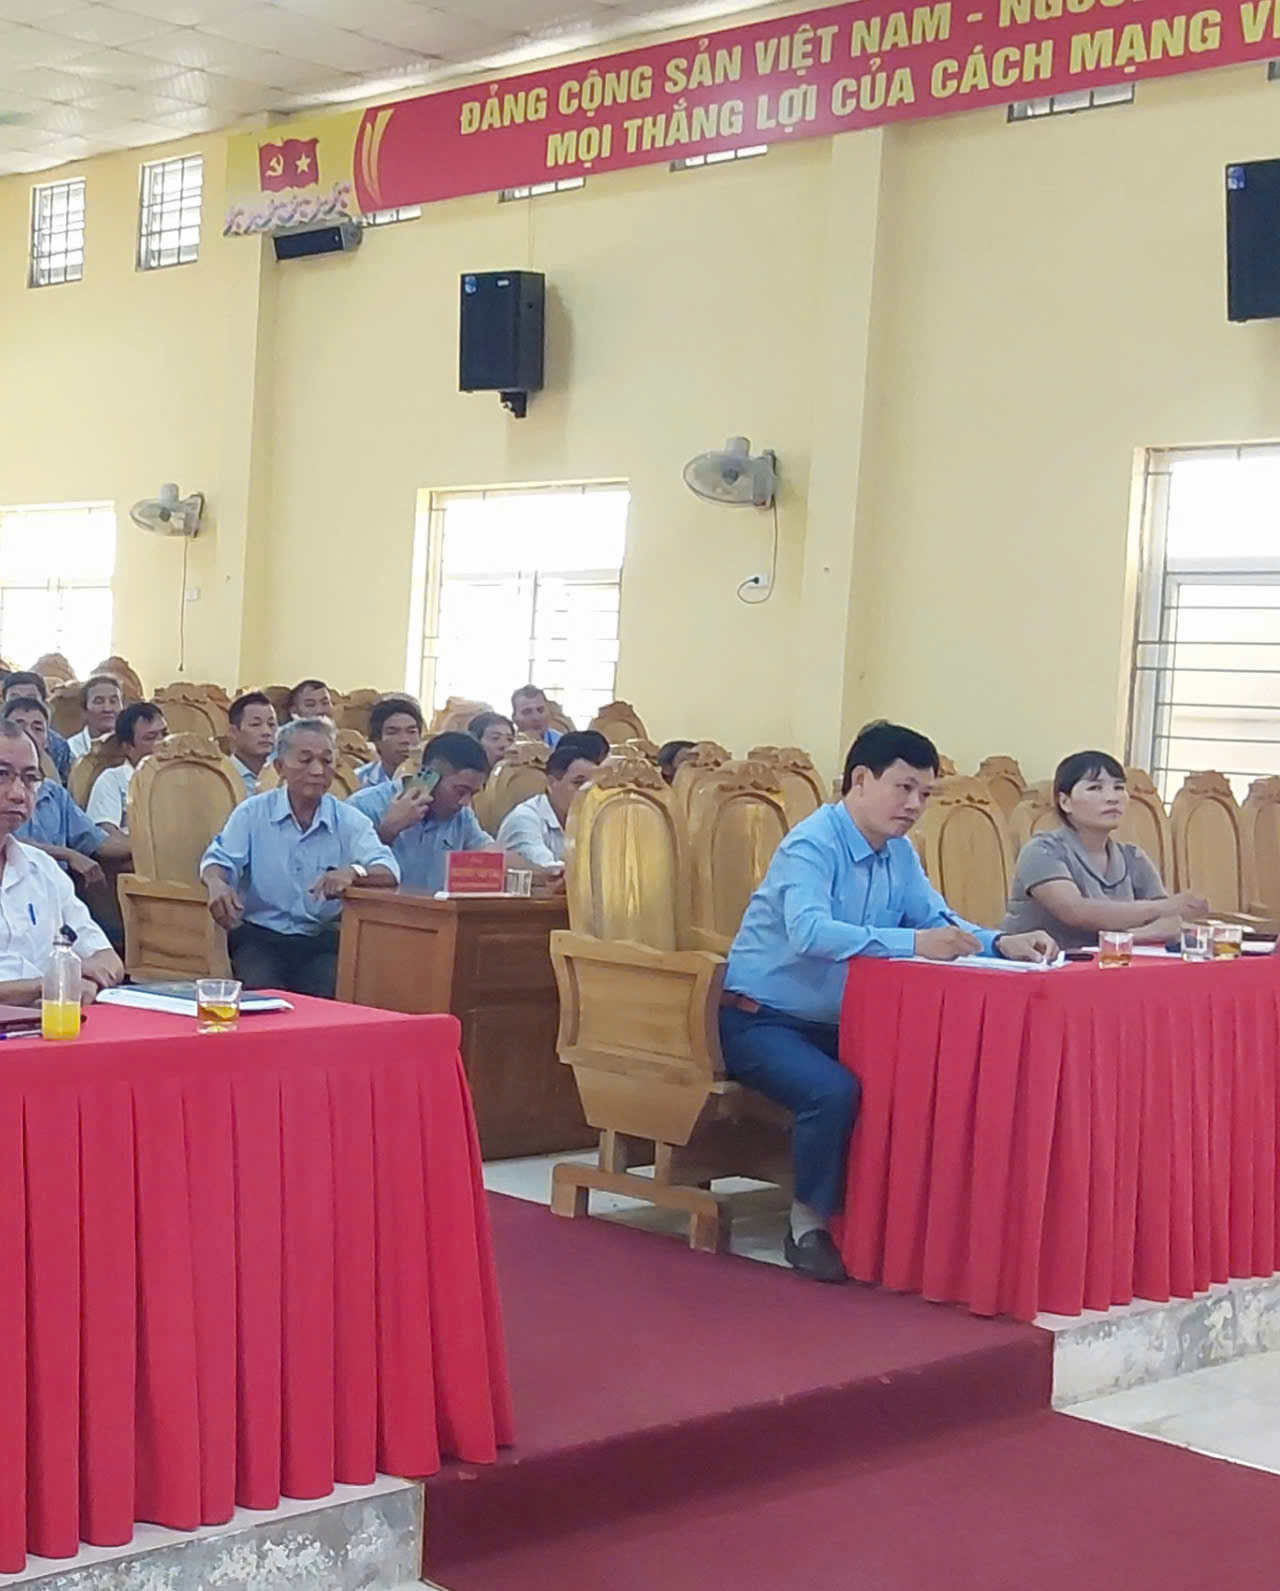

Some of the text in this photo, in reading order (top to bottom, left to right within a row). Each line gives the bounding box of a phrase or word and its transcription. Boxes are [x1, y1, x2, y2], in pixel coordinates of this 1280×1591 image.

[460, 84, 548, 134] ĐẢNG
[558, 65, 654, 117] CỘNG
[664, 38, 742, 94] SẢN
[755, 23, 839, 76] VIỆT
[850, 2, 952, 57] NAM
[546, 124, 612, 168] MỌI
[624, 97, 744, 153] THẮNG
[756, 83, 818, 133] LỢI
[831, 58, 916, 116] CỦA
[930, 40, 1054, 98] CÁCH
[1069, 10, 1222, 75] MẠNG
